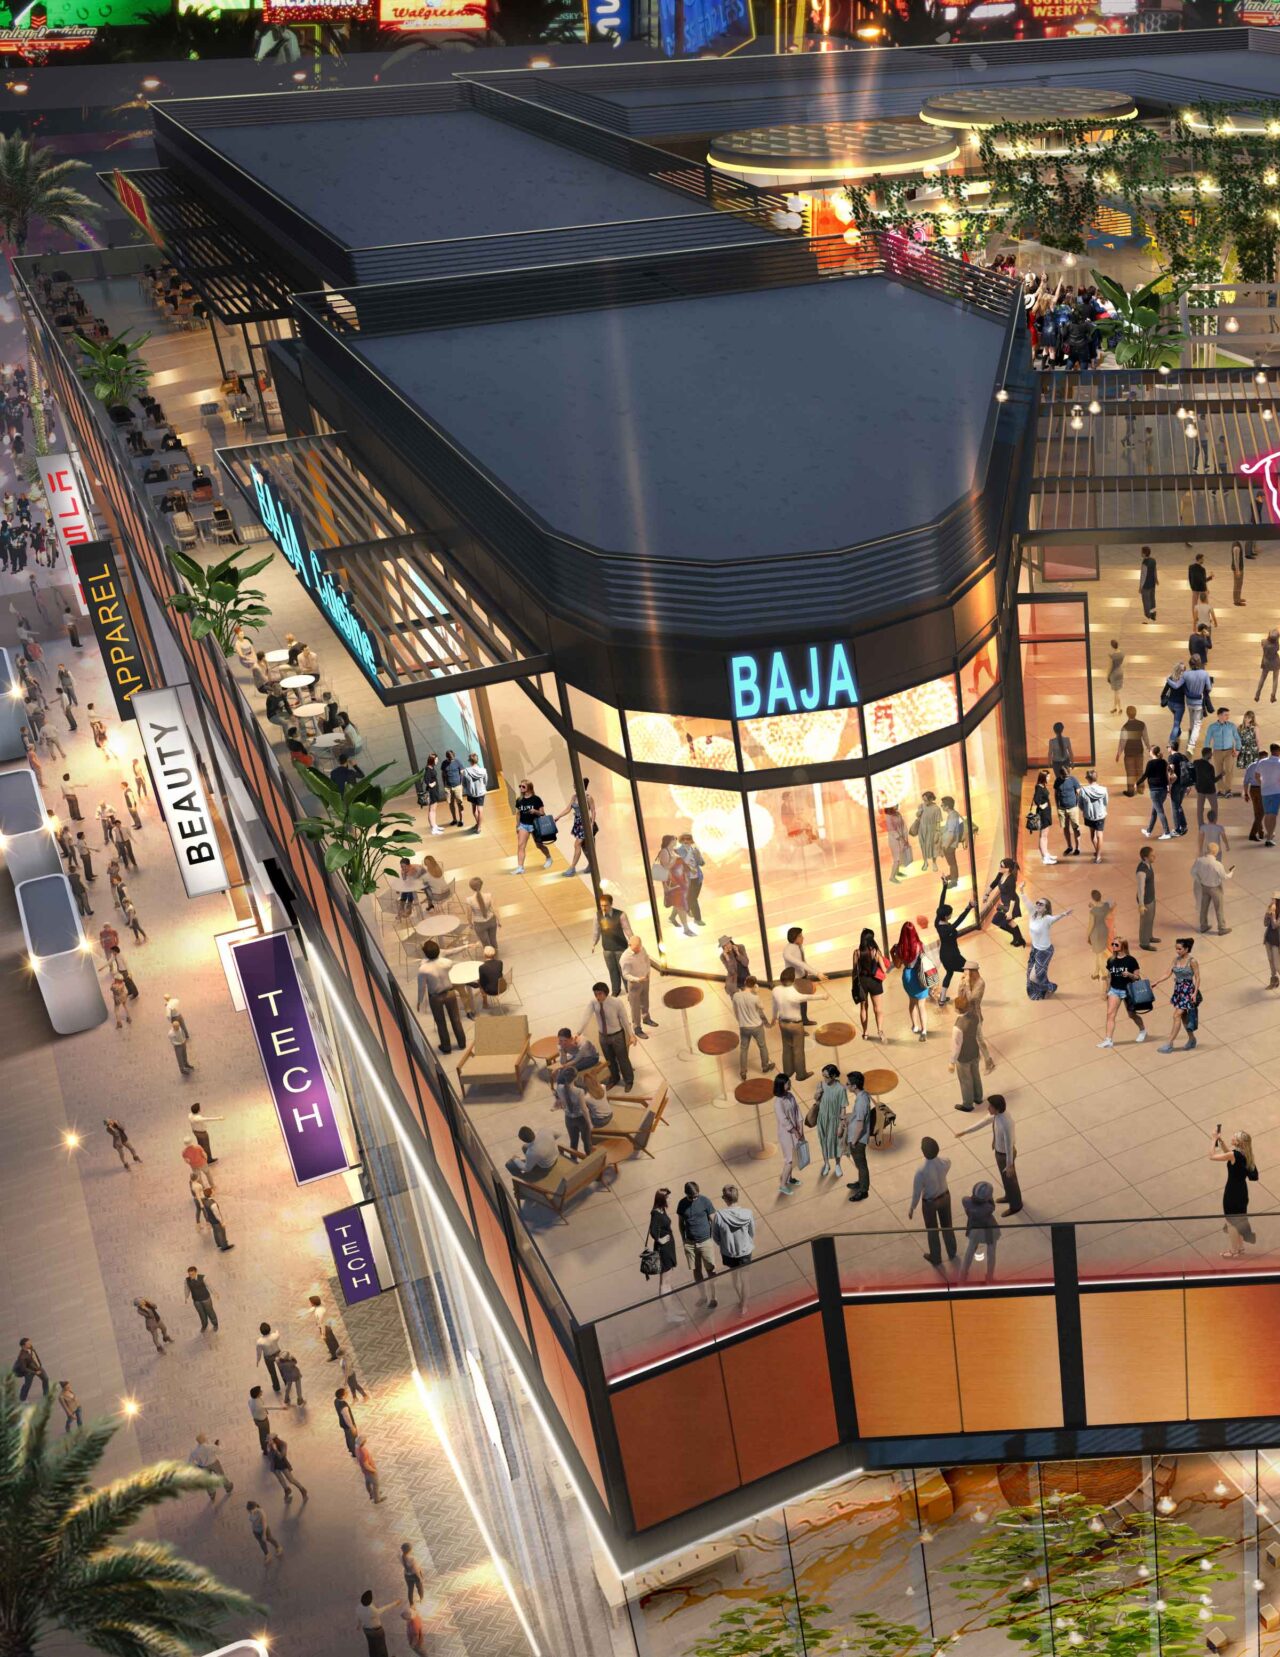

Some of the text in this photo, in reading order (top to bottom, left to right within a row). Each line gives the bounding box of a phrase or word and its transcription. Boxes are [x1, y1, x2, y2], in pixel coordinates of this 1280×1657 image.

[88, 563, 144, 702] APPAREL
[250, 463, 377, 675] BAJA Cuisine
[731, 643, 858, 718] BAJA
[149, 722, 215, 866] BEAUTY
[257, 989, 324, 1133] TECH
[334, 1223, 371, 1289] TECH
